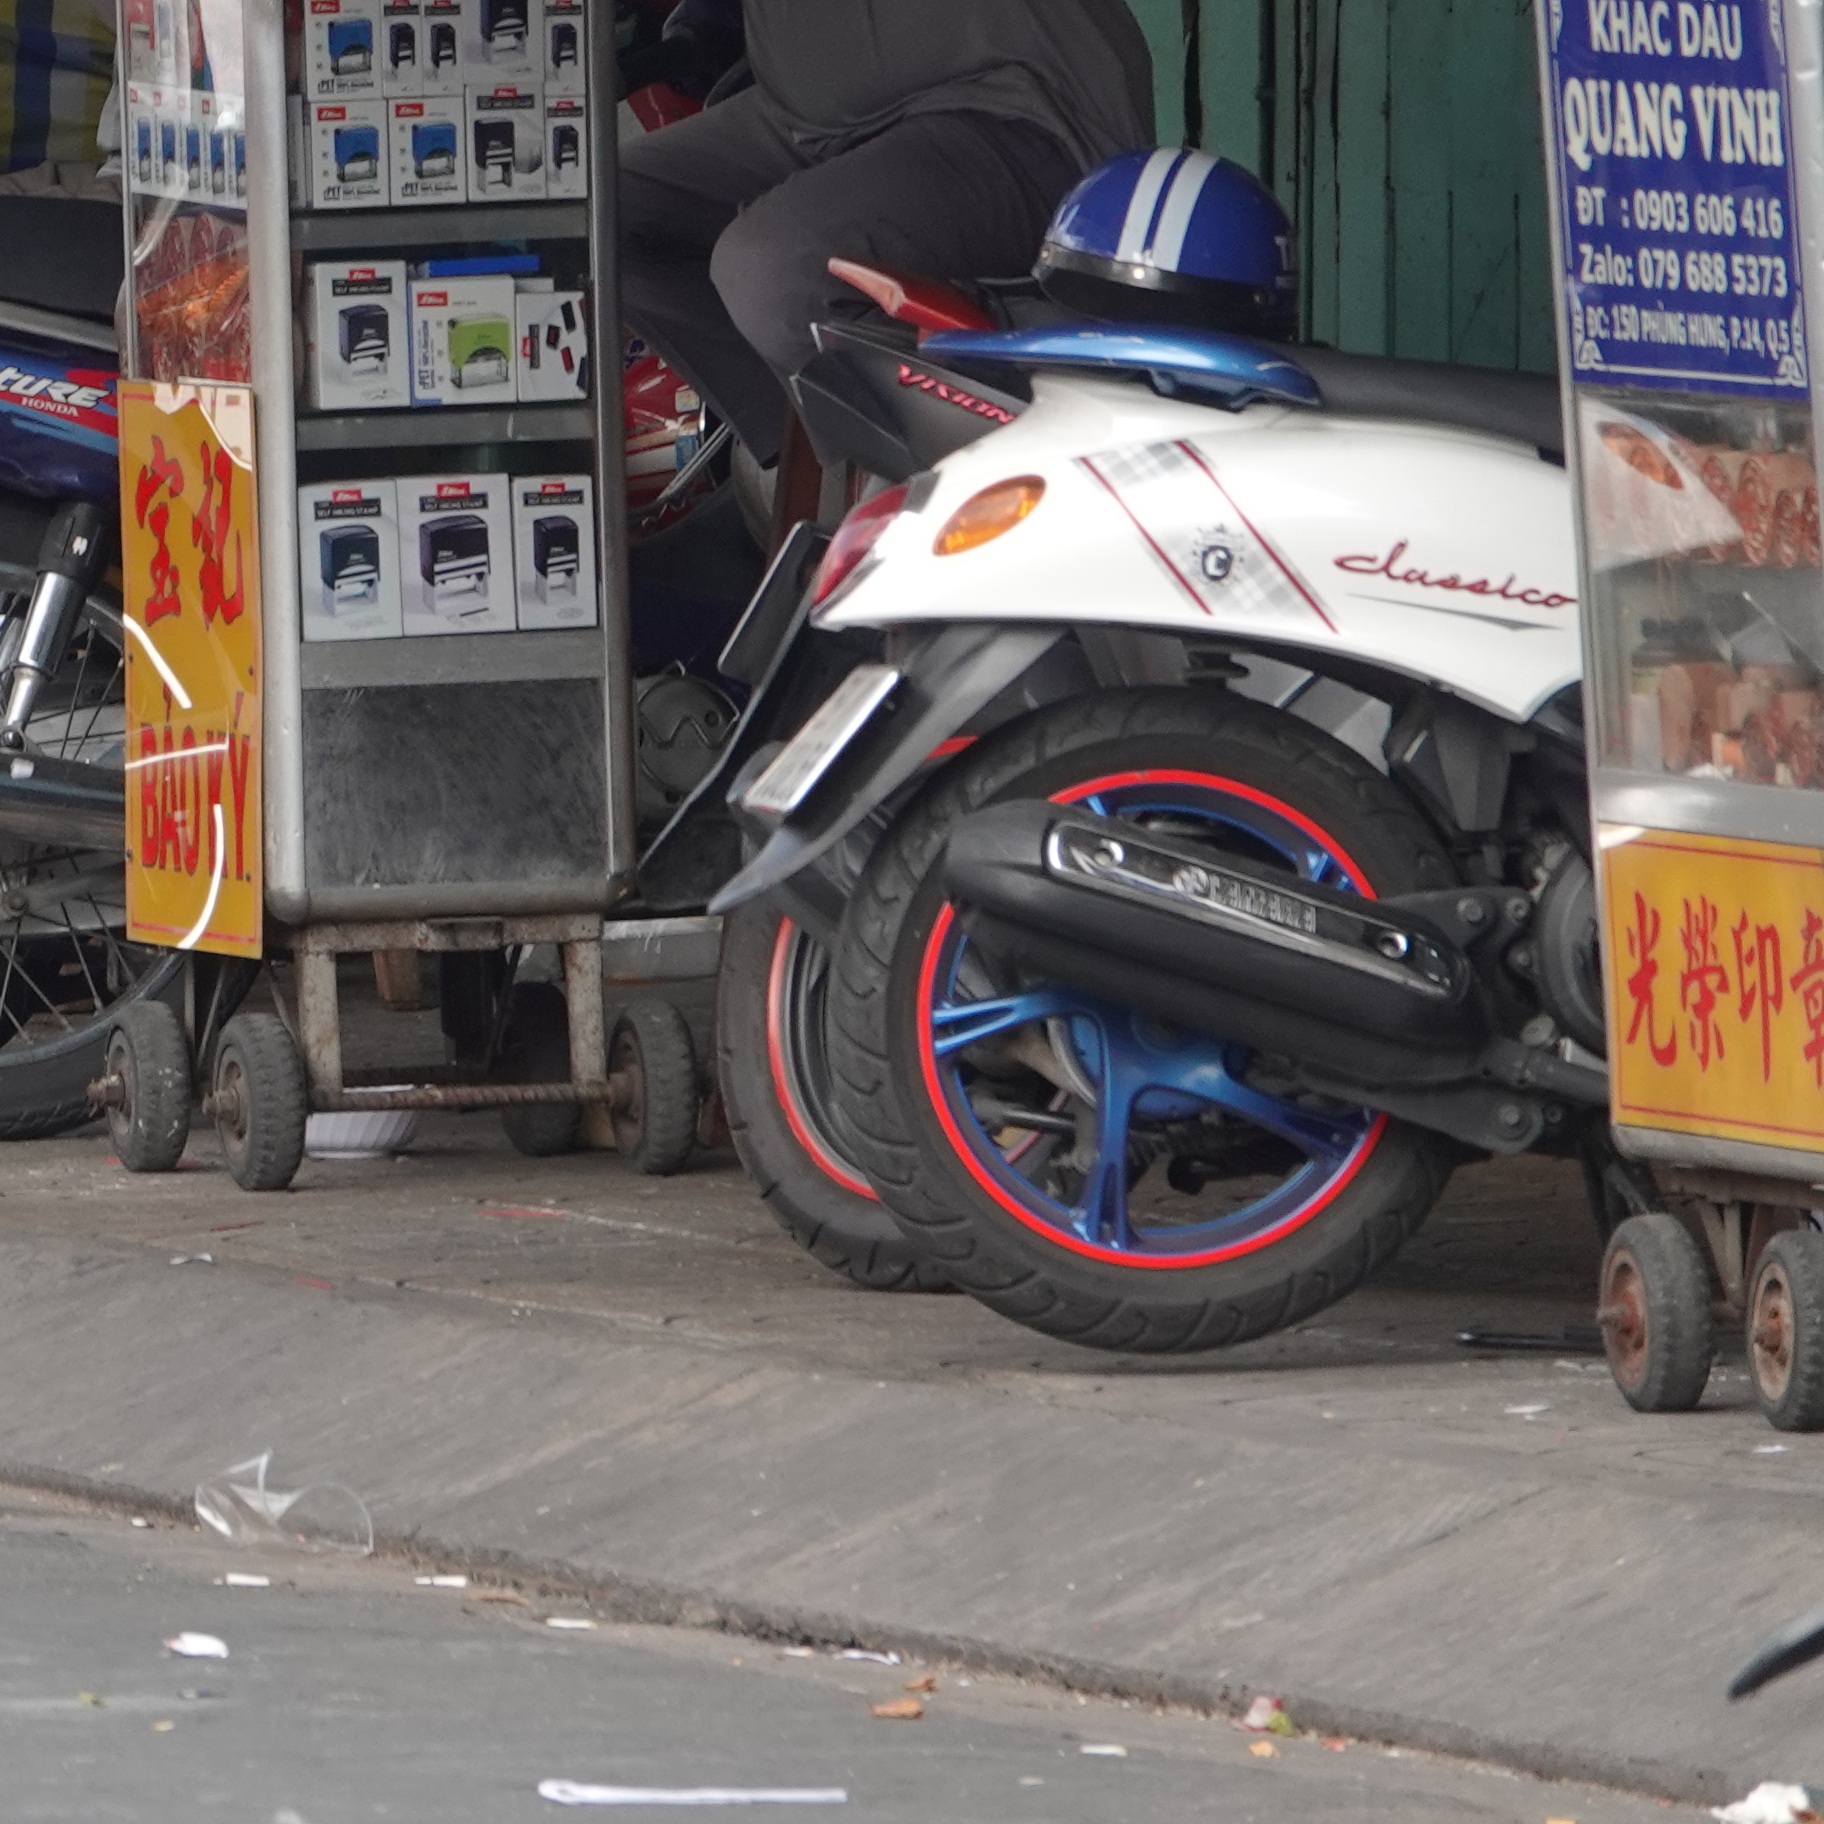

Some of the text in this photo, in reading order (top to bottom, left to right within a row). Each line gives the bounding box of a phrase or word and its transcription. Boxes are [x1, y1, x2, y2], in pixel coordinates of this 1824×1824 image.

[1563, 76, 1785, 173] QUANG VINH
[1574, 185, 1607, 227] ĐT
[1633, 188, 1690, 234] 0903
[1693, 192, 1738, 238] 606
[1740, 195, 1785, 240] 416
[1577, 242, 1789, 299] Zalo: 079 688 5373
[1611, 303, 1641, 343] 150
[1639, 298, 1688, 346] PHÙNG
[1686, 311, 1731, 356] HƯNG,
[21, 395, 81, 418] HONDA
[898, 364, 1016, 426] VISION
[140, 680, 201, 877] BẢO
